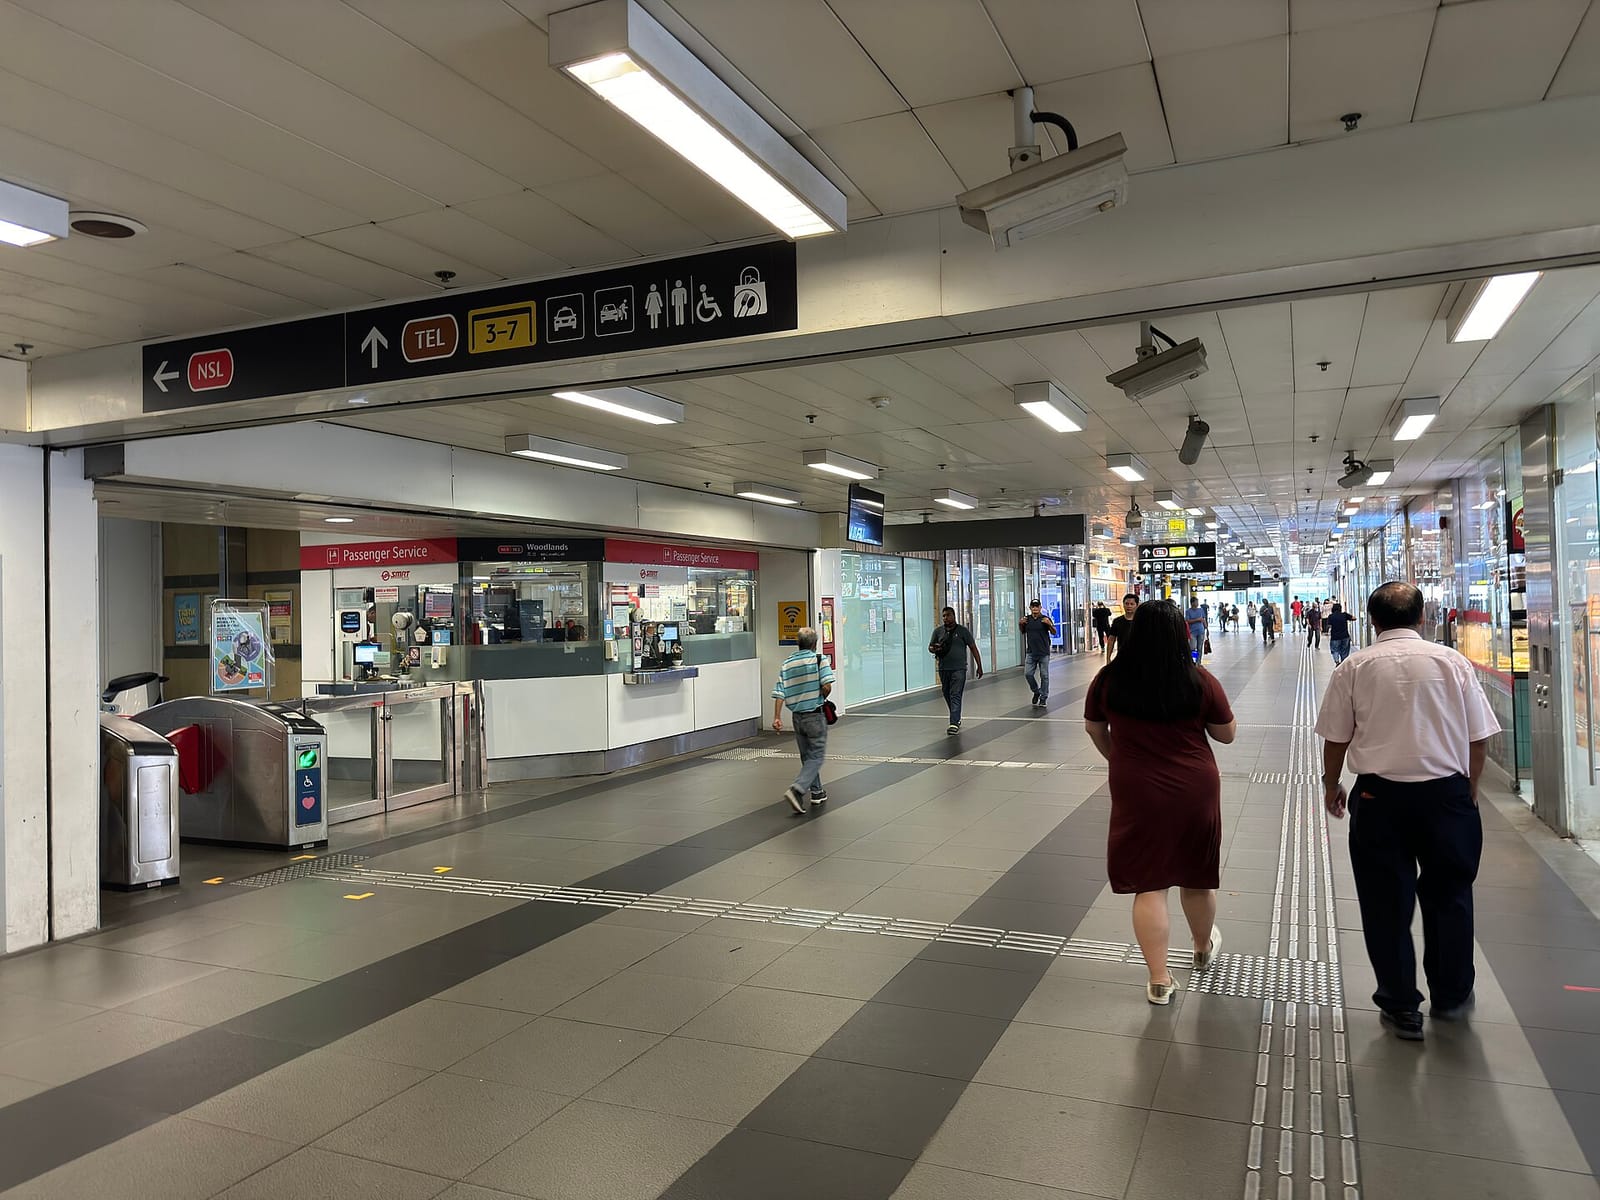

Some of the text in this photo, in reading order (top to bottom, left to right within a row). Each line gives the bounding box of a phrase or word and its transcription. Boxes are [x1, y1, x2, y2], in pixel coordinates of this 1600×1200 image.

[415, 328, 445, 349] TEL
[198, 362, 223, 380] NSL
[343, 546, 428, 562] Passenger Service
[526, 543, 568, 551] Woodlands
[673, 551, 719, 564] Passenger Service
